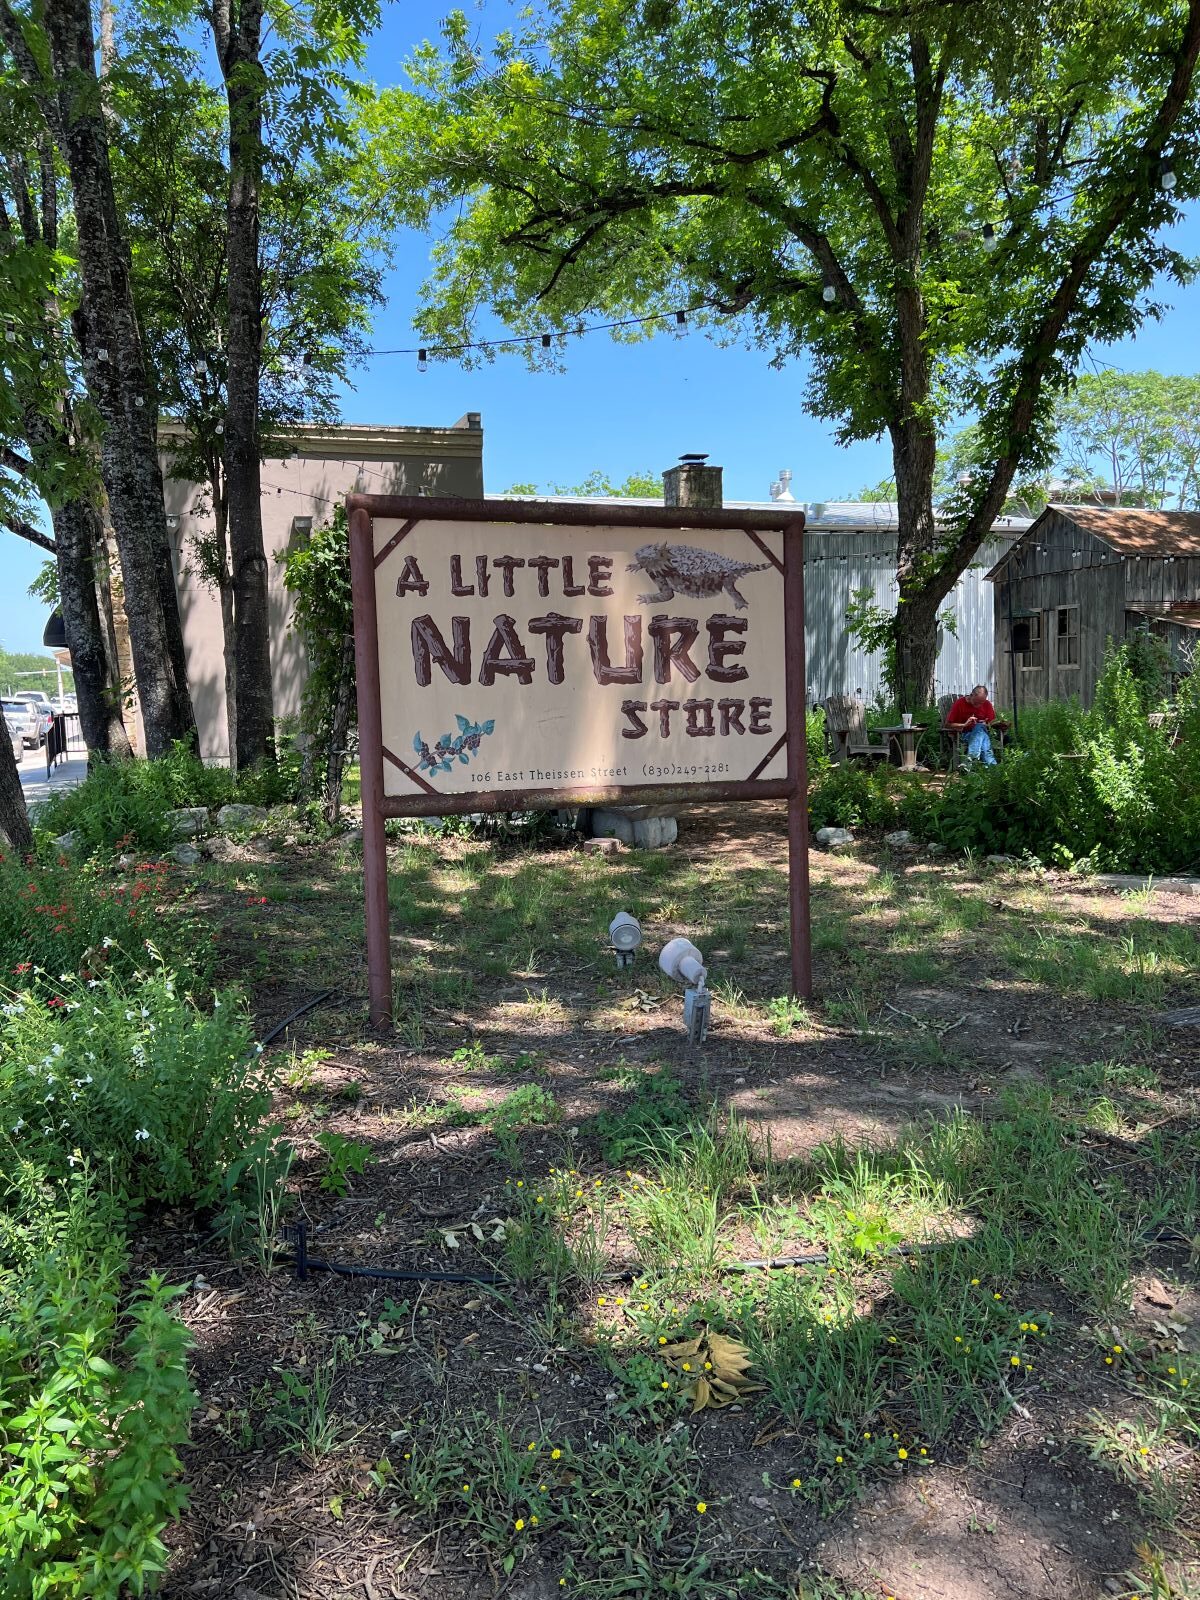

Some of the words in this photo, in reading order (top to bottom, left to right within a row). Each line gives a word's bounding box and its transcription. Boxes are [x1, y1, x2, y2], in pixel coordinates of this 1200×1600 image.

[395, 555, 430, 598] A
[450, 554, 615, 598] LITTLE
[410, 611, 750, 688] NATURE
[620, 696, 774, 740] STORE
[471, 773, 491, 783] 106
[497, 771, 524, 782] East
[529, 768, 585, 781] Theissen
[590, 766, 628, 779] Street
